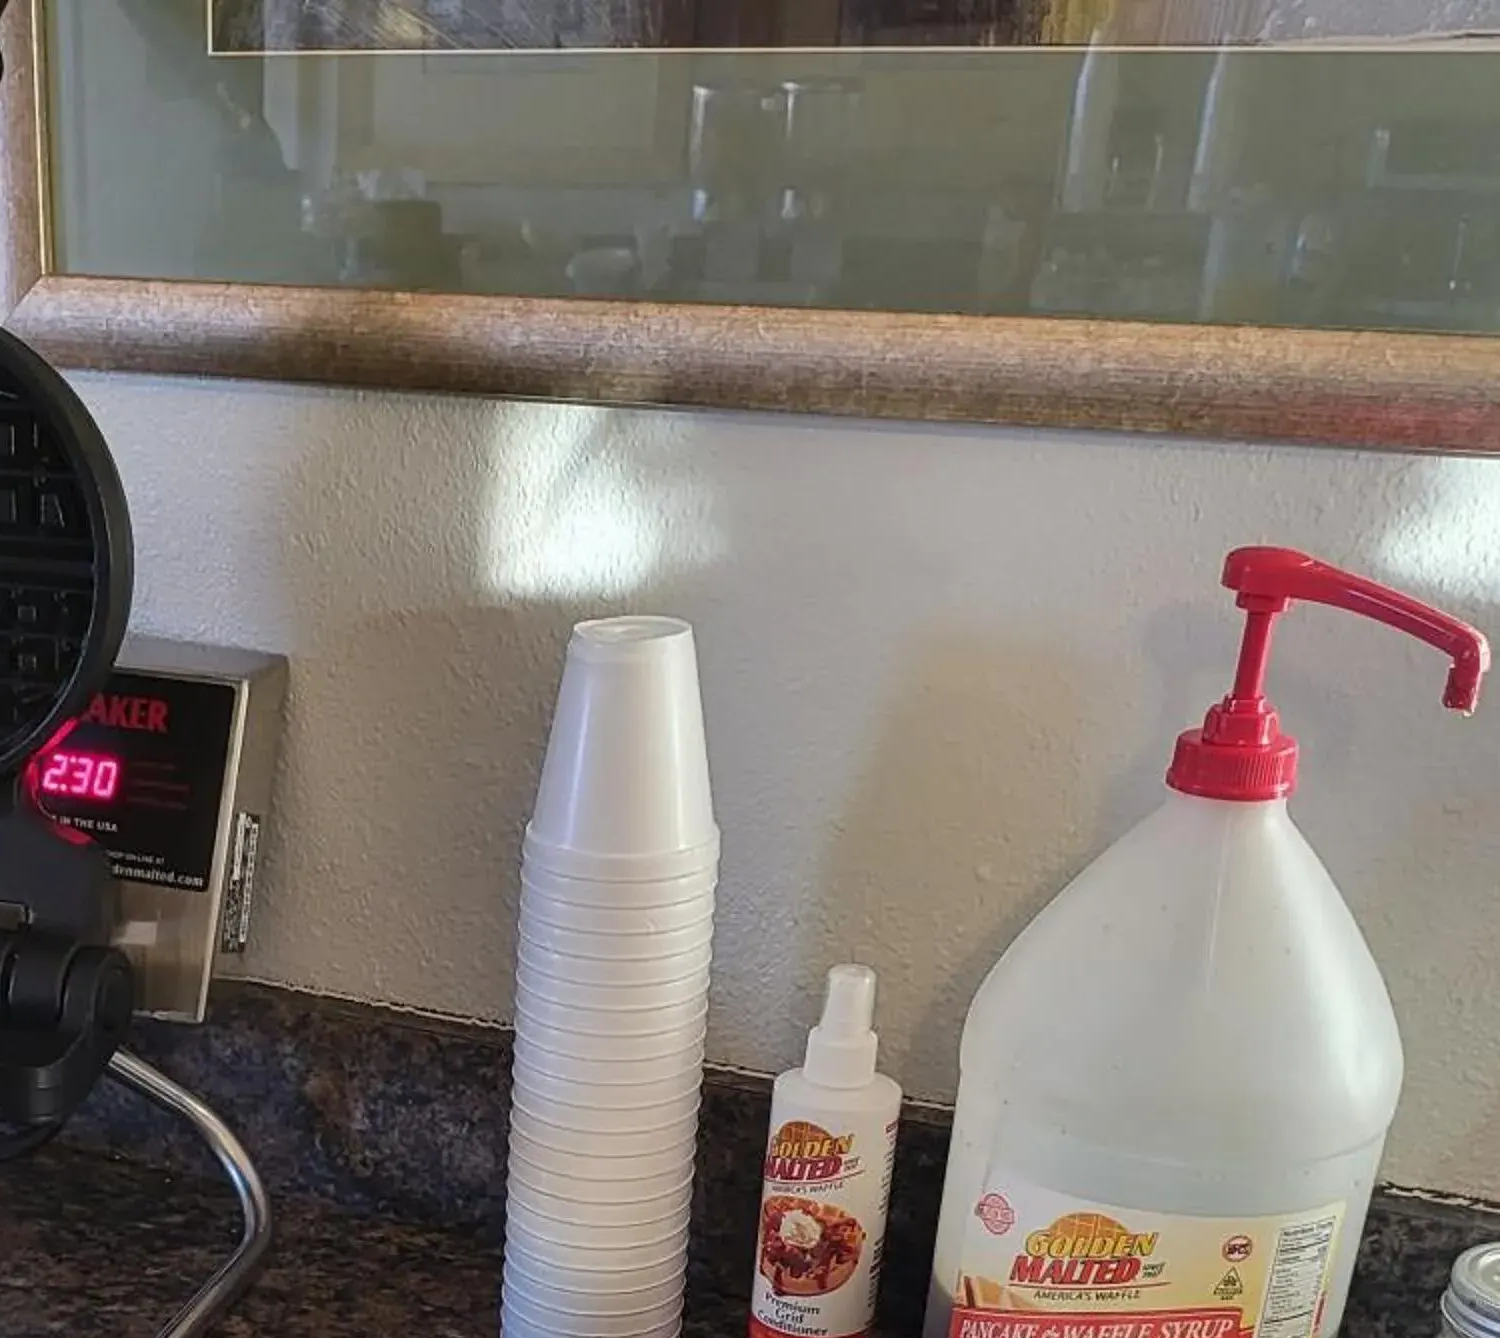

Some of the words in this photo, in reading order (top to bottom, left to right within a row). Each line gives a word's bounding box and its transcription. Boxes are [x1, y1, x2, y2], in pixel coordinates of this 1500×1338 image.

[80, 692, 168, 734] AKER
[42, 754, 117, 798] 2:30
[59, 815, 71, 825] IN
[74, 817, 94, 829] THE
[97, 822, 118, 833] USA
[111, 863, 203, 887] denmalted.com
[1026, 1230, 1160, 1258] GOLDEN
[1010, 1255, 1142, 1285] MALTED
[765, 1291, 821, 1315] Premium
[1034, 1290, 1092, 1301] AMERICA'S
[1095, 1290, 1141, 1301] WAFFLE
[757, 1310, 830, 1336] Conditioner
